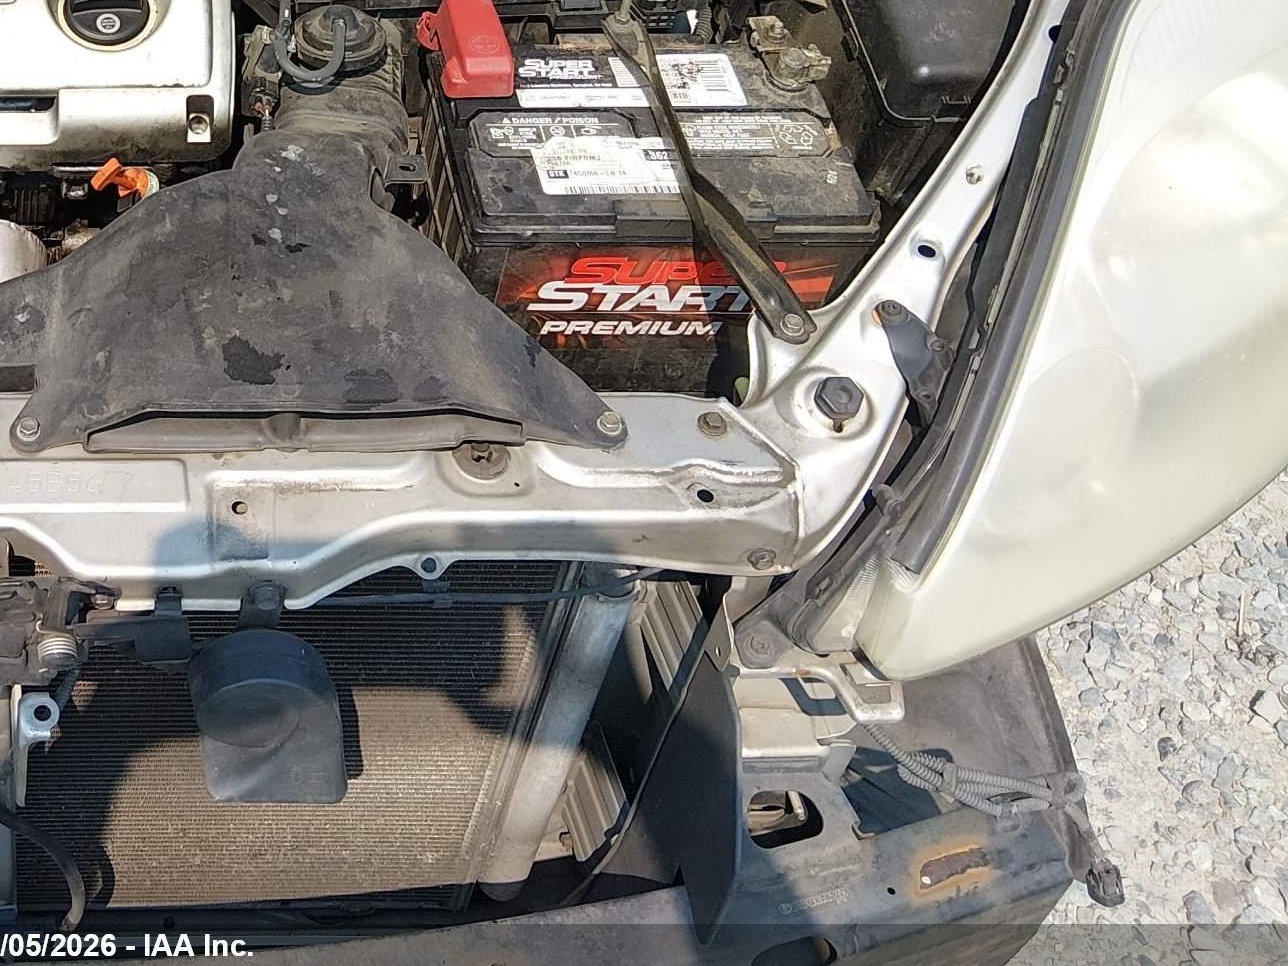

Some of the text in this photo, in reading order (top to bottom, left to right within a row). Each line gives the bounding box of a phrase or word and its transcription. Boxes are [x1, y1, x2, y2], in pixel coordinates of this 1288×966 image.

[524, 58, 593, 68] SUPER
[518, 66, 596, 78] START
[565, 256, 786, 285] SUPE
[539, 320, 722, 336] PREMIUM
